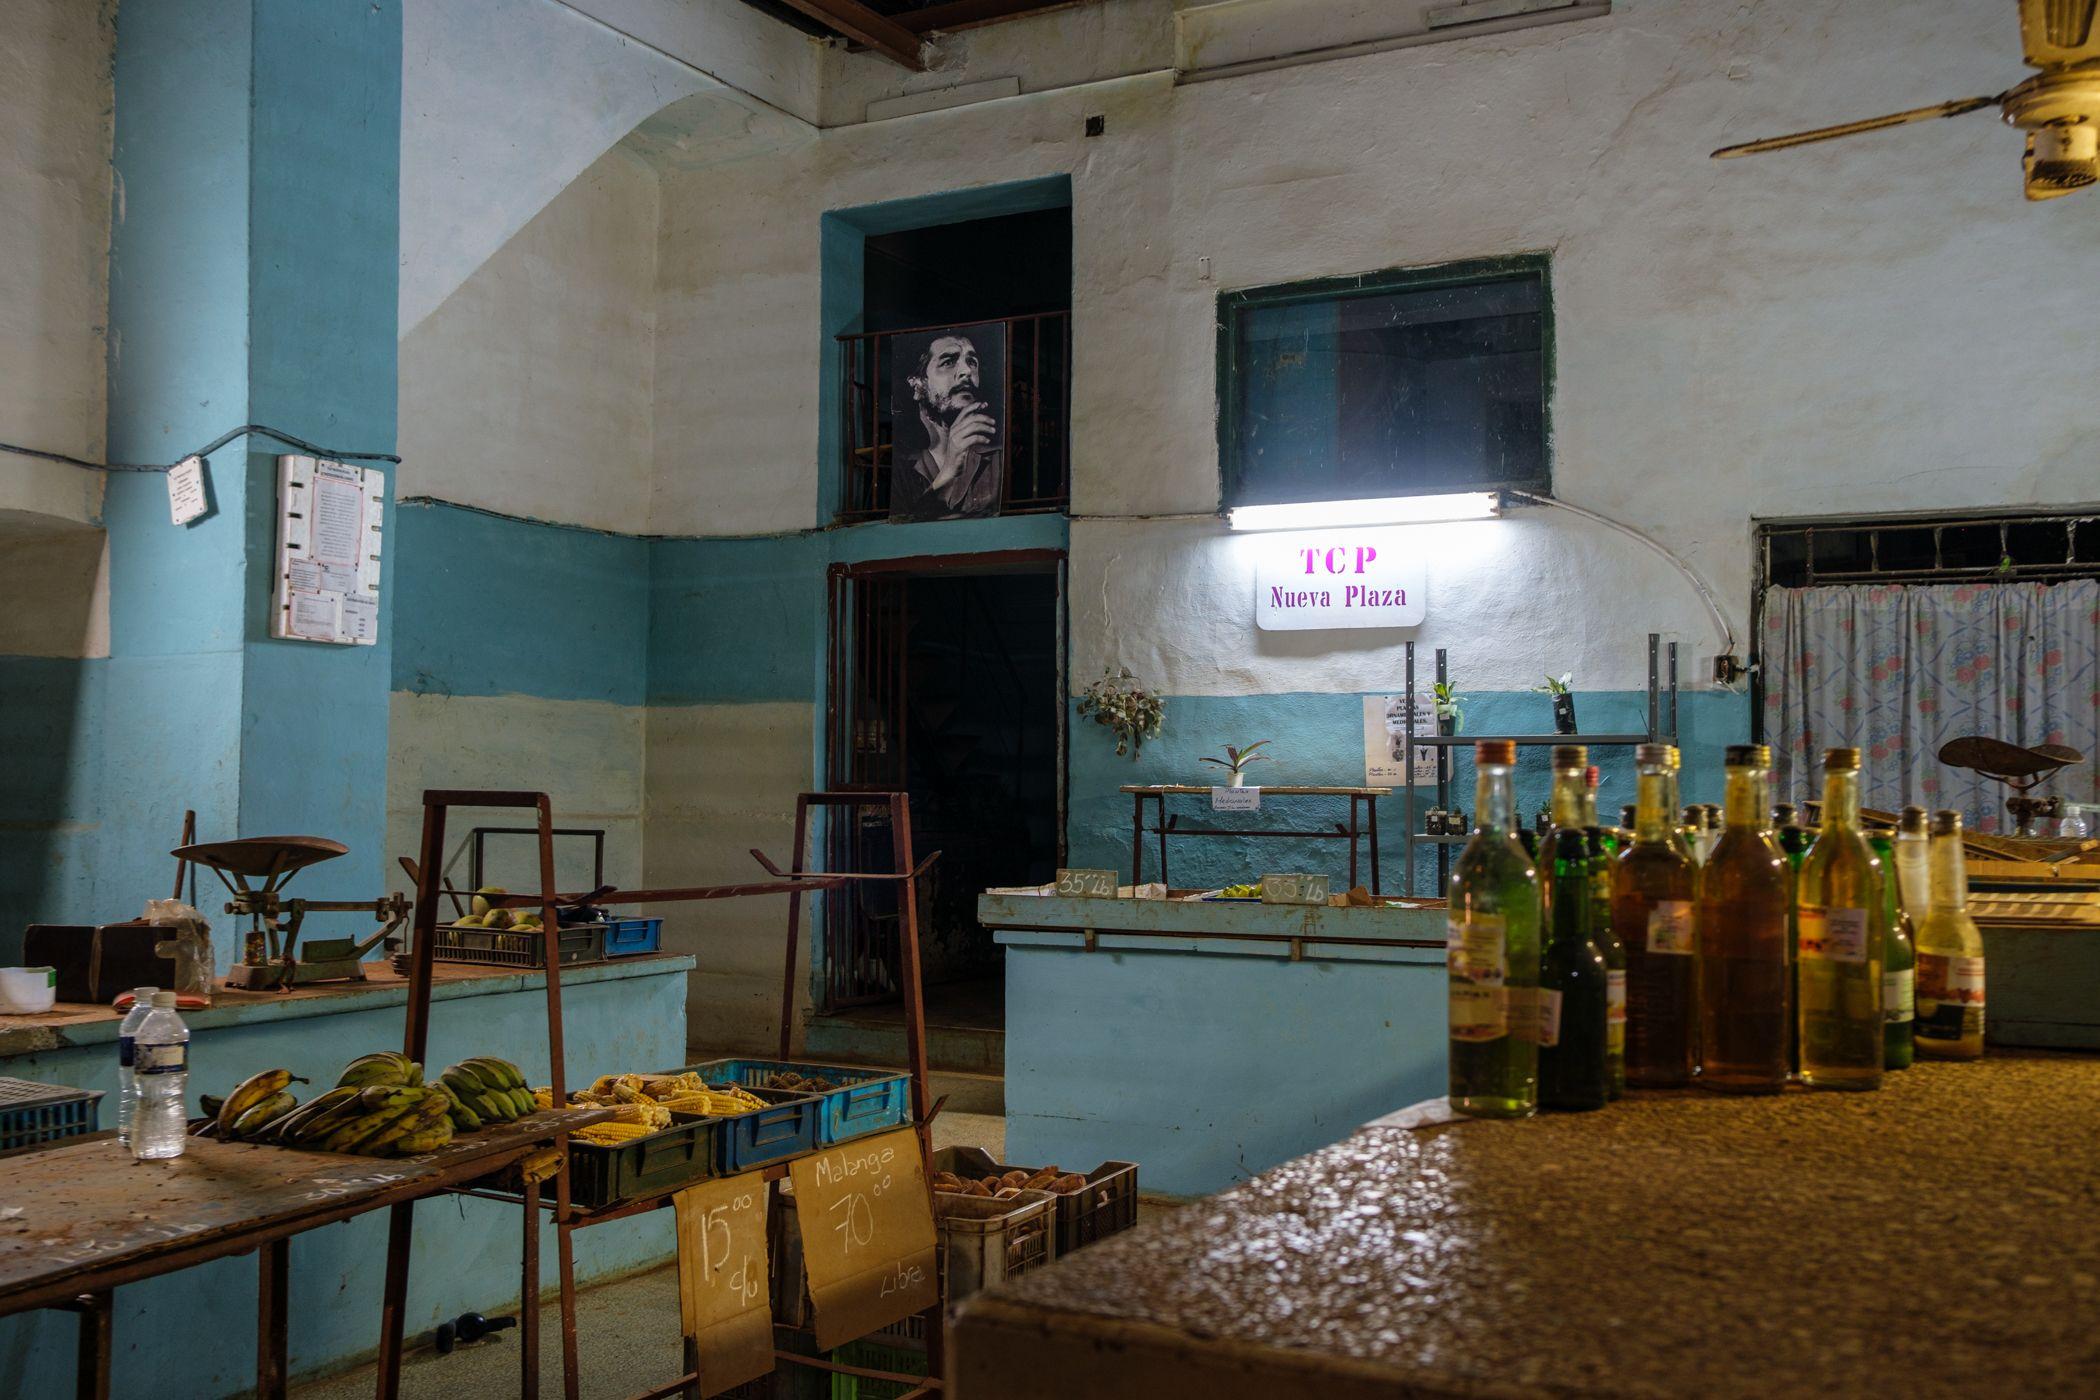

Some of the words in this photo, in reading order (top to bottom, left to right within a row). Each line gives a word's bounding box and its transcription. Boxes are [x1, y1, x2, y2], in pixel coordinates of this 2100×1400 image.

[1300, 547, 1377, 574] TCP
[1271, 586, 1331, 608] Nueva
[1345, 585, 1407, 608] Plaza
[816, 1148, 895, 1187] Malanga
[880, 1262, 926, 1299] Libra
